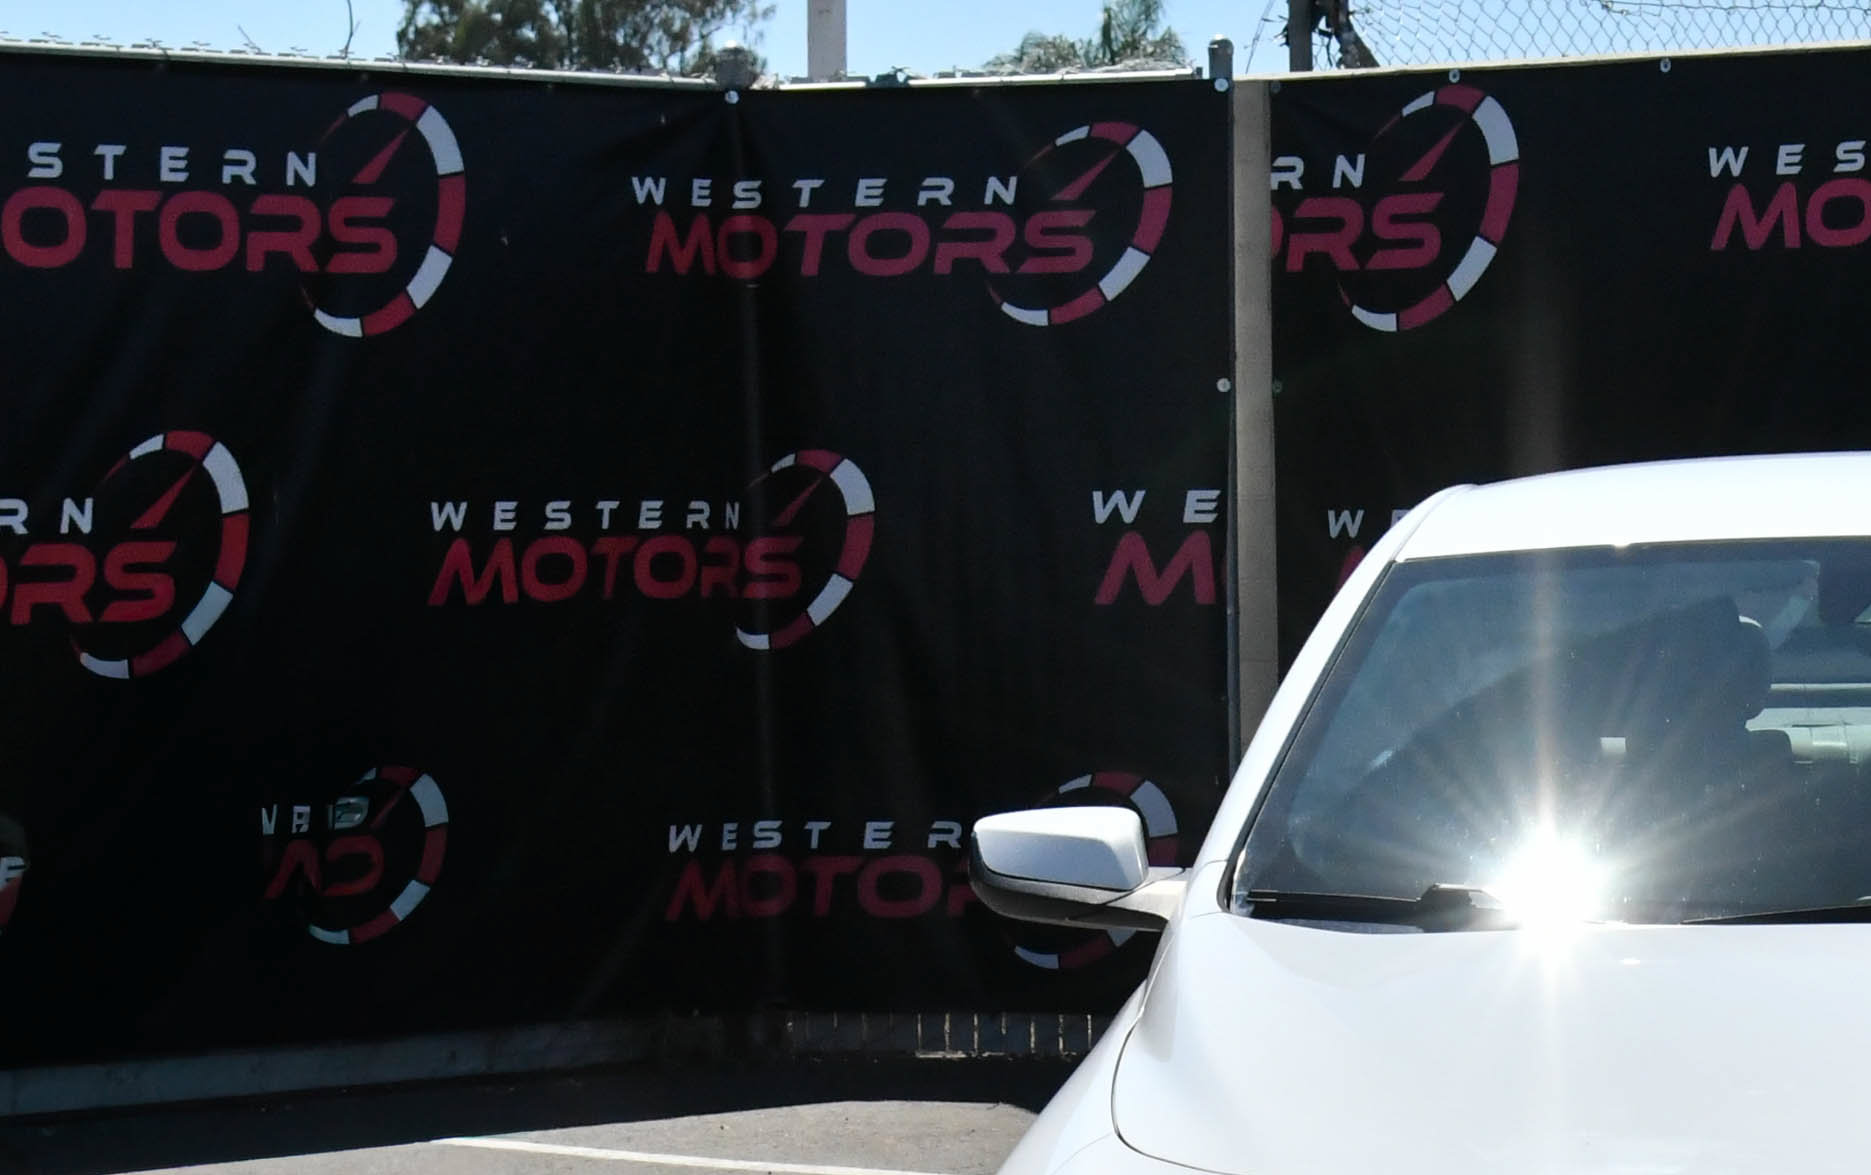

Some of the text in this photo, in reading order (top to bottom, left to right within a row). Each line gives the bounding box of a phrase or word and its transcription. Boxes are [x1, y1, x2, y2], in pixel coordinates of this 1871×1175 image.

[27, 142, 317, 187] STERN
[631, 175, 1018, 209] WESTERN
[1, 186, 398, 273] OTORS
[645, 210, 1096, 276] MOTORS
[1271, 192, 1445, 272] RS
[430, 500, 741, 532] WESTERN
[0, 540, 177, 625] RS
[428, 534, 802, 605] MOTORS
[1095, 530, 1228, 606] M
[668, 820, 963, 853] WESTER
[665, 854, 978, 922] MOTO
